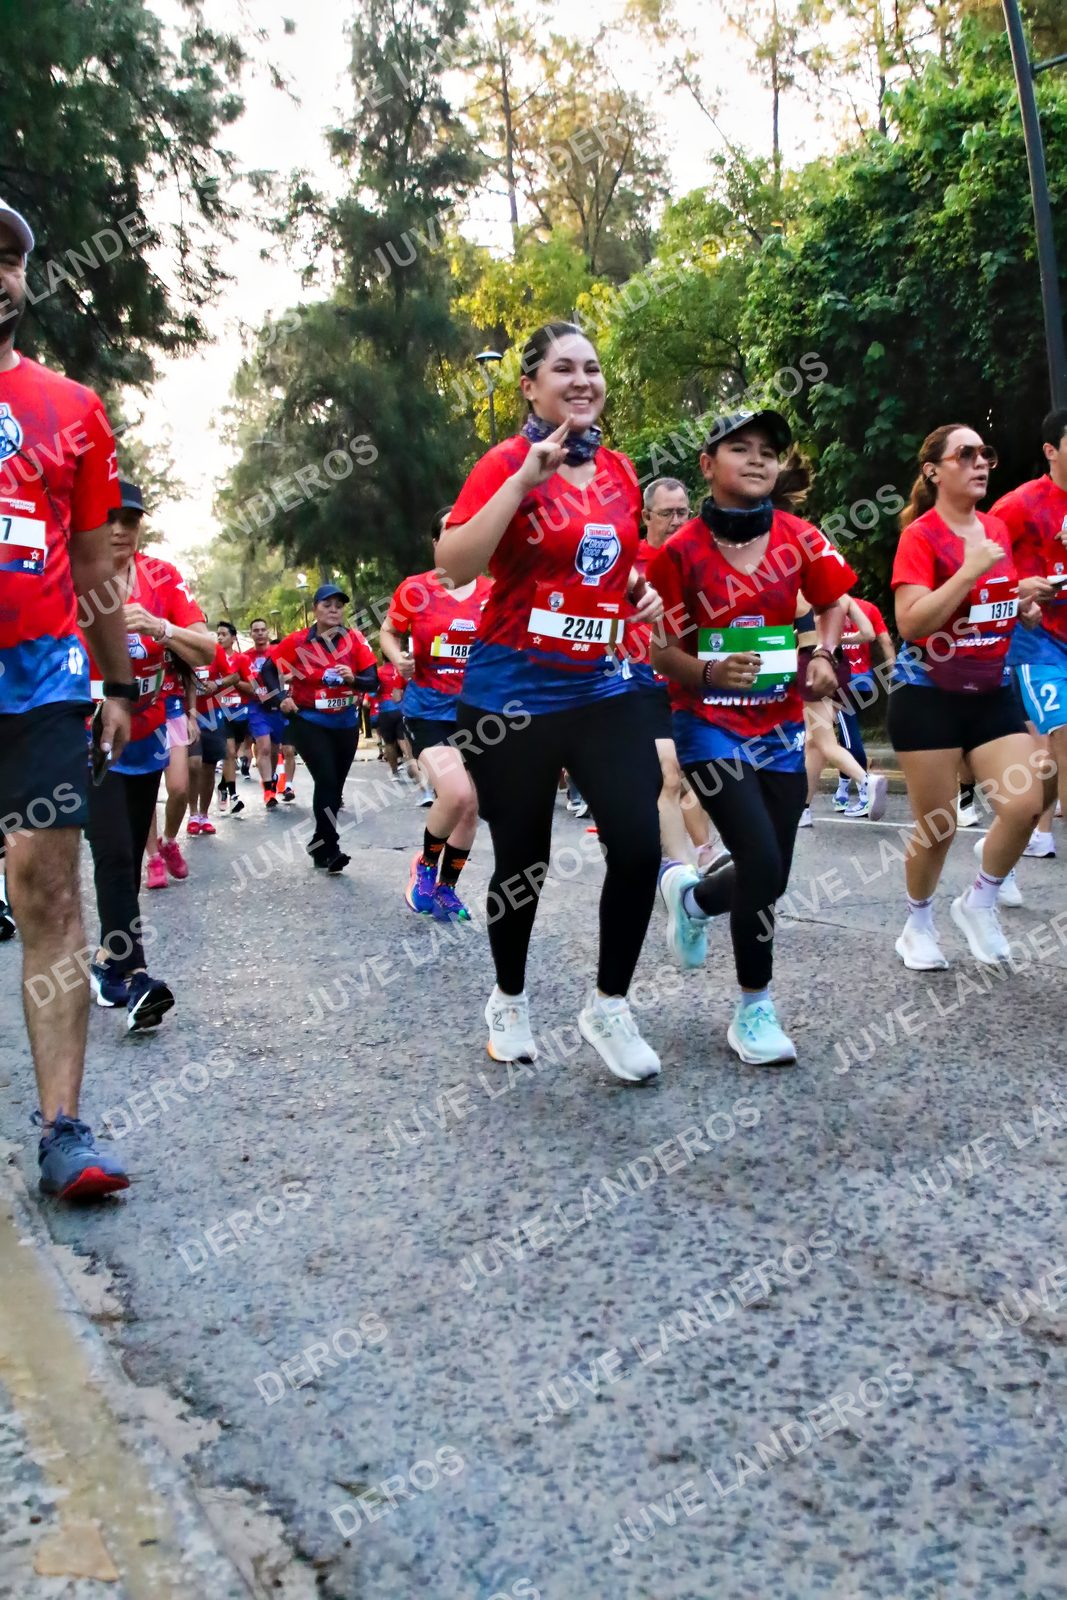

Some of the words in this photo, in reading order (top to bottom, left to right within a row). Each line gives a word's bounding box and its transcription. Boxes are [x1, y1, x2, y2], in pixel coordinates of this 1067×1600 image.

[588, 540, 611, 550] Global
[583, 549, 601, 557] Race
[991, 601, 1014, 620] 1376
[562, 617, 603, 641] 2244
[450, 645, 471, 657] 148
[1040, 683, 1060, 712] 2
